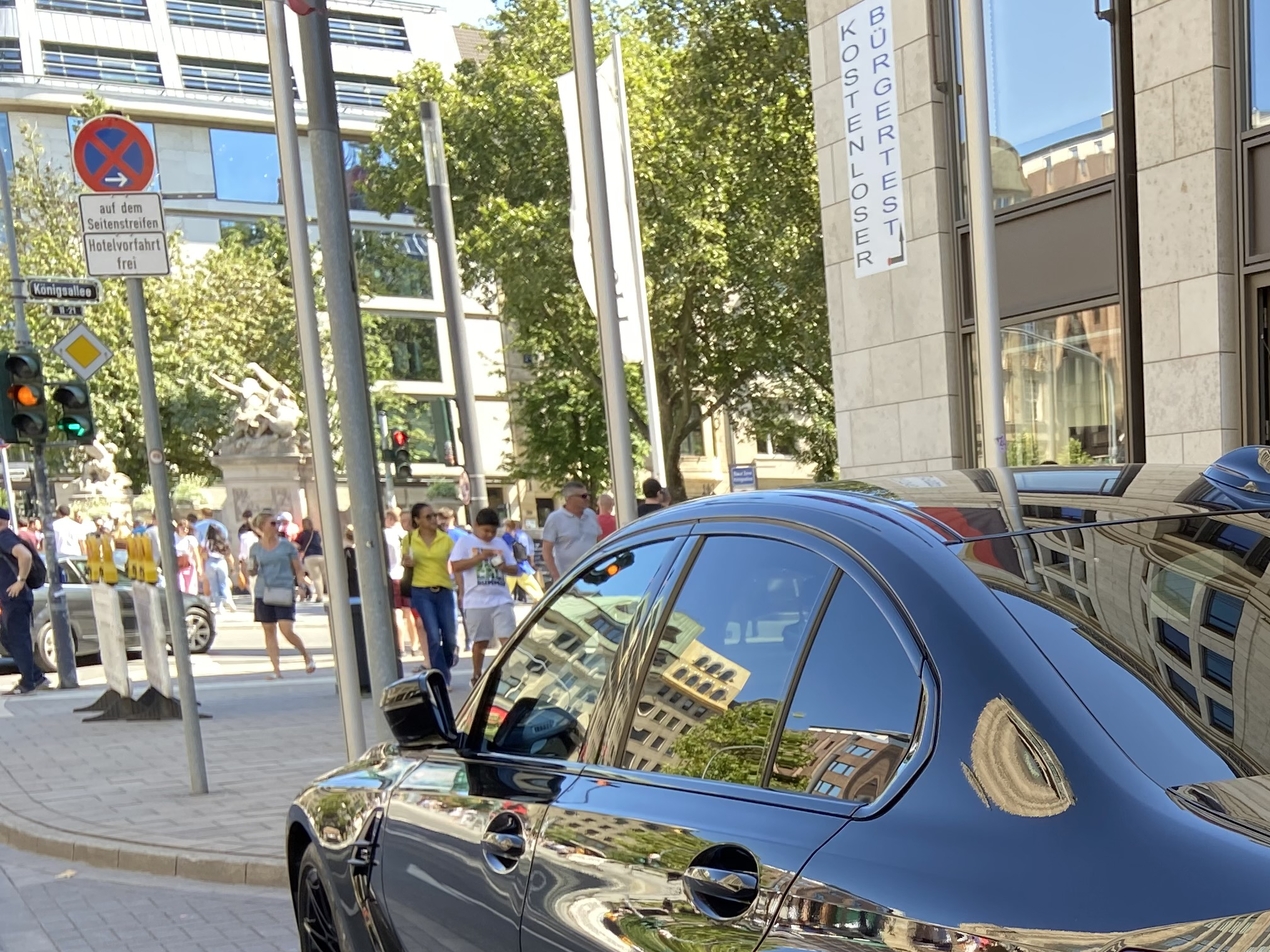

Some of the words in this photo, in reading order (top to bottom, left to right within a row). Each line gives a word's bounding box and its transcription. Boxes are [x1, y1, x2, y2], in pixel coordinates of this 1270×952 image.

[869, 5, 899, 236] BÜRGERTEST
[840, 18, 874, 269] KOSTENLOSER
[99, 202, 116, 214] auf
[121, 202, 143, 214] dem
[87, 216, 159, 230] Seitenstreifen
[88, 237, 161, 252] Hotelvorfahrt
[116, 256, 137, 270] frei
[33, 283, 92, 298] Königsallee
